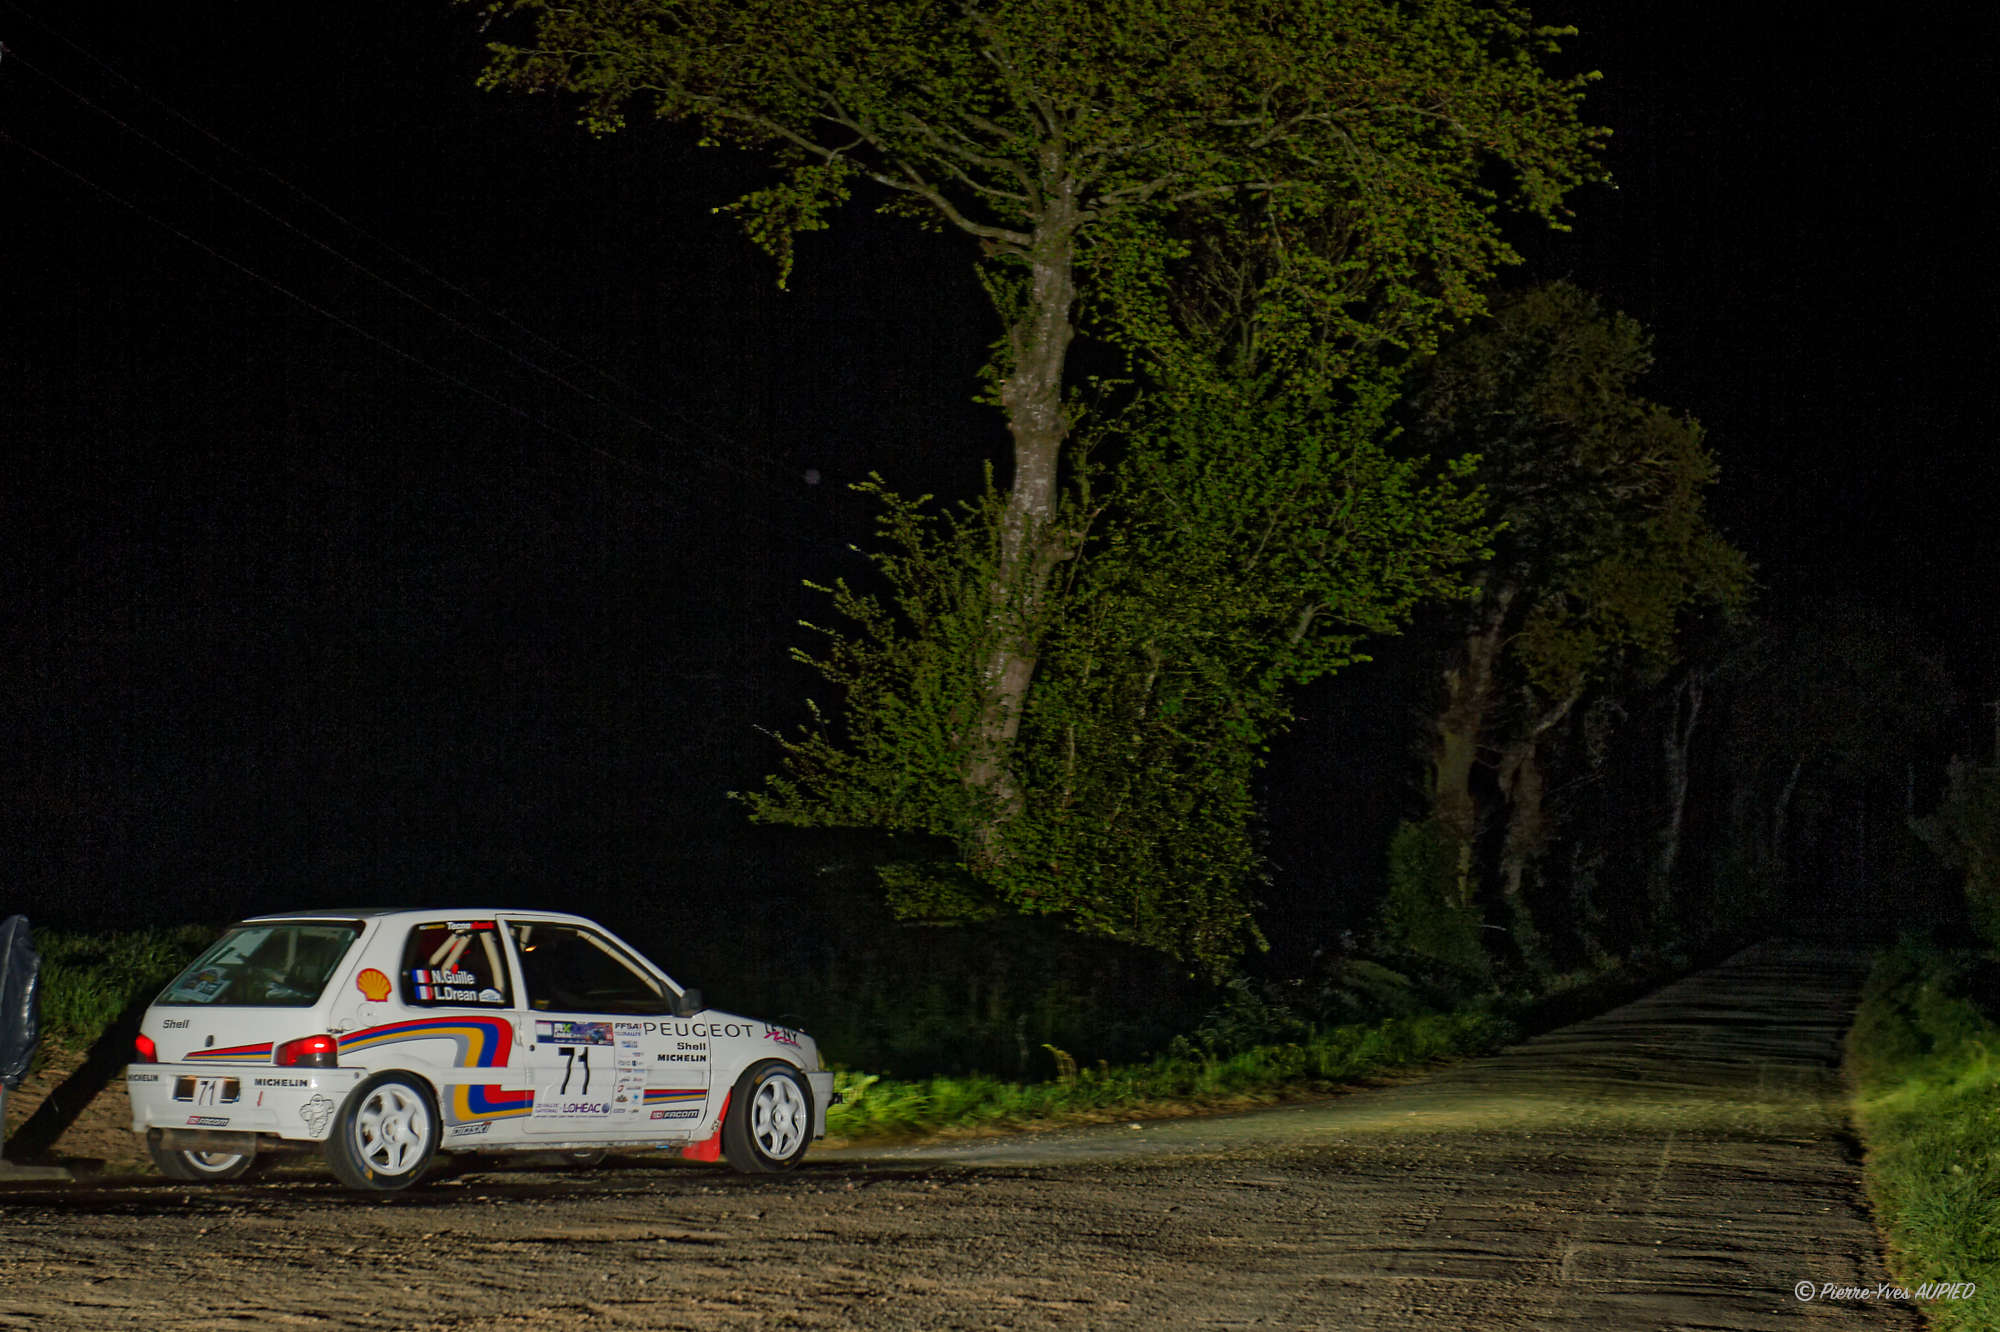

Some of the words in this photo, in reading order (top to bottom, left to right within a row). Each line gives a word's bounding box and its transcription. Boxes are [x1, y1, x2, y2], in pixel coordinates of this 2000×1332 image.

[431, 969, 475, 984] N.Guille
[434, 986, 478, 1000] L.Drean
[162, 1019, 191, 1029] Shell
[643, 1022, 754, 1037] PEUGEOT
[677, 1041, 707, 1050] Shell
[657, 1053, 707, 1062] MICHELIN
[558, 1046, 591, 1095] 71
[254, 1078, 308, 1087] MICHELIN
[198, 1080, 217, 1106] 71
[562, 1102, 602, 1113] LOHÉAC
